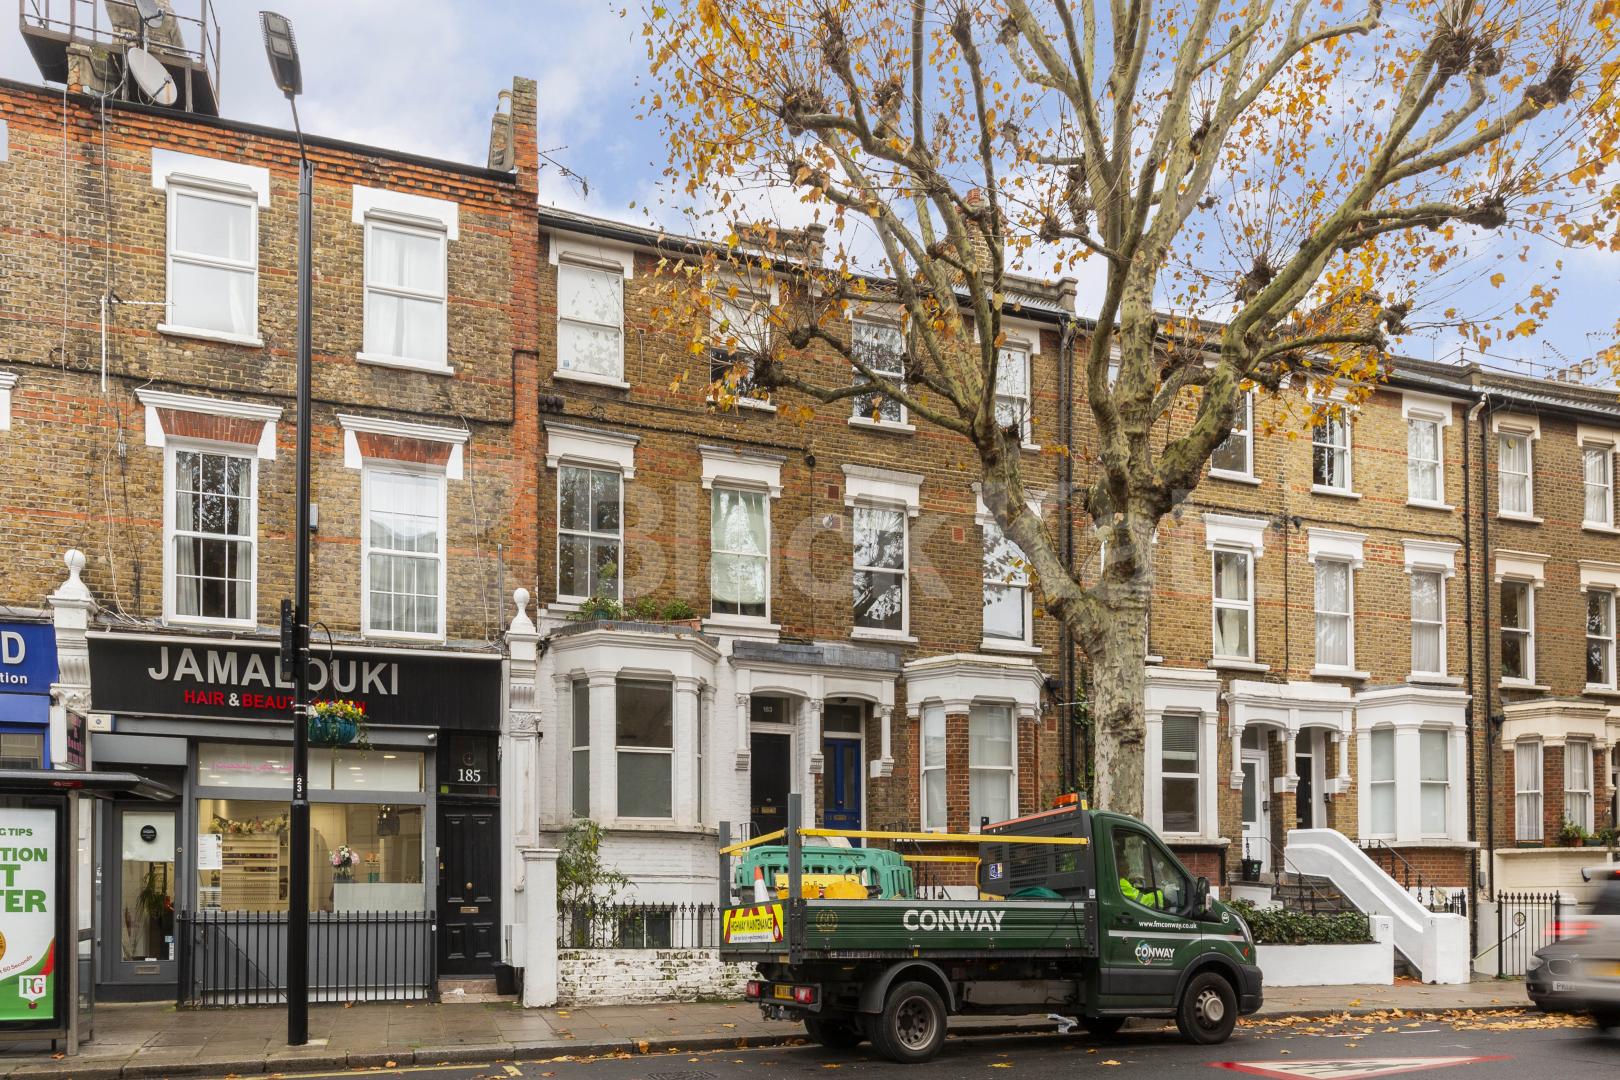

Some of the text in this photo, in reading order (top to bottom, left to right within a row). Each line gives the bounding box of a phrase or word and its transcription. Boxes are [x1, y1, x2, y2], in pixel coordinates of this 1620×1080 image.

[0, 671, 28, 684] tion
[147, 645, 399, 696] JAMALOUKI
[184, 689, 224, 706] HAIR
[228, 692, 240, 707] &
[241, 692, 296, 711] BEAUT
[457, 768, 481, 783] 185
[8, 827, 33, 837] TIPS
[0, 847, 48, 862] TION
[0, 863, 21, 887] T
[0, 889, 47, 913] ER
[902, 909, 1006, 932] CONWAY
[1138, 920, 1197, 930] www.fmconway.co.uk
[1135, 946, 1176, 958] CONWAY
[11, 954, 33, 970] Seconds
[22, 977, 43, 995] PG
